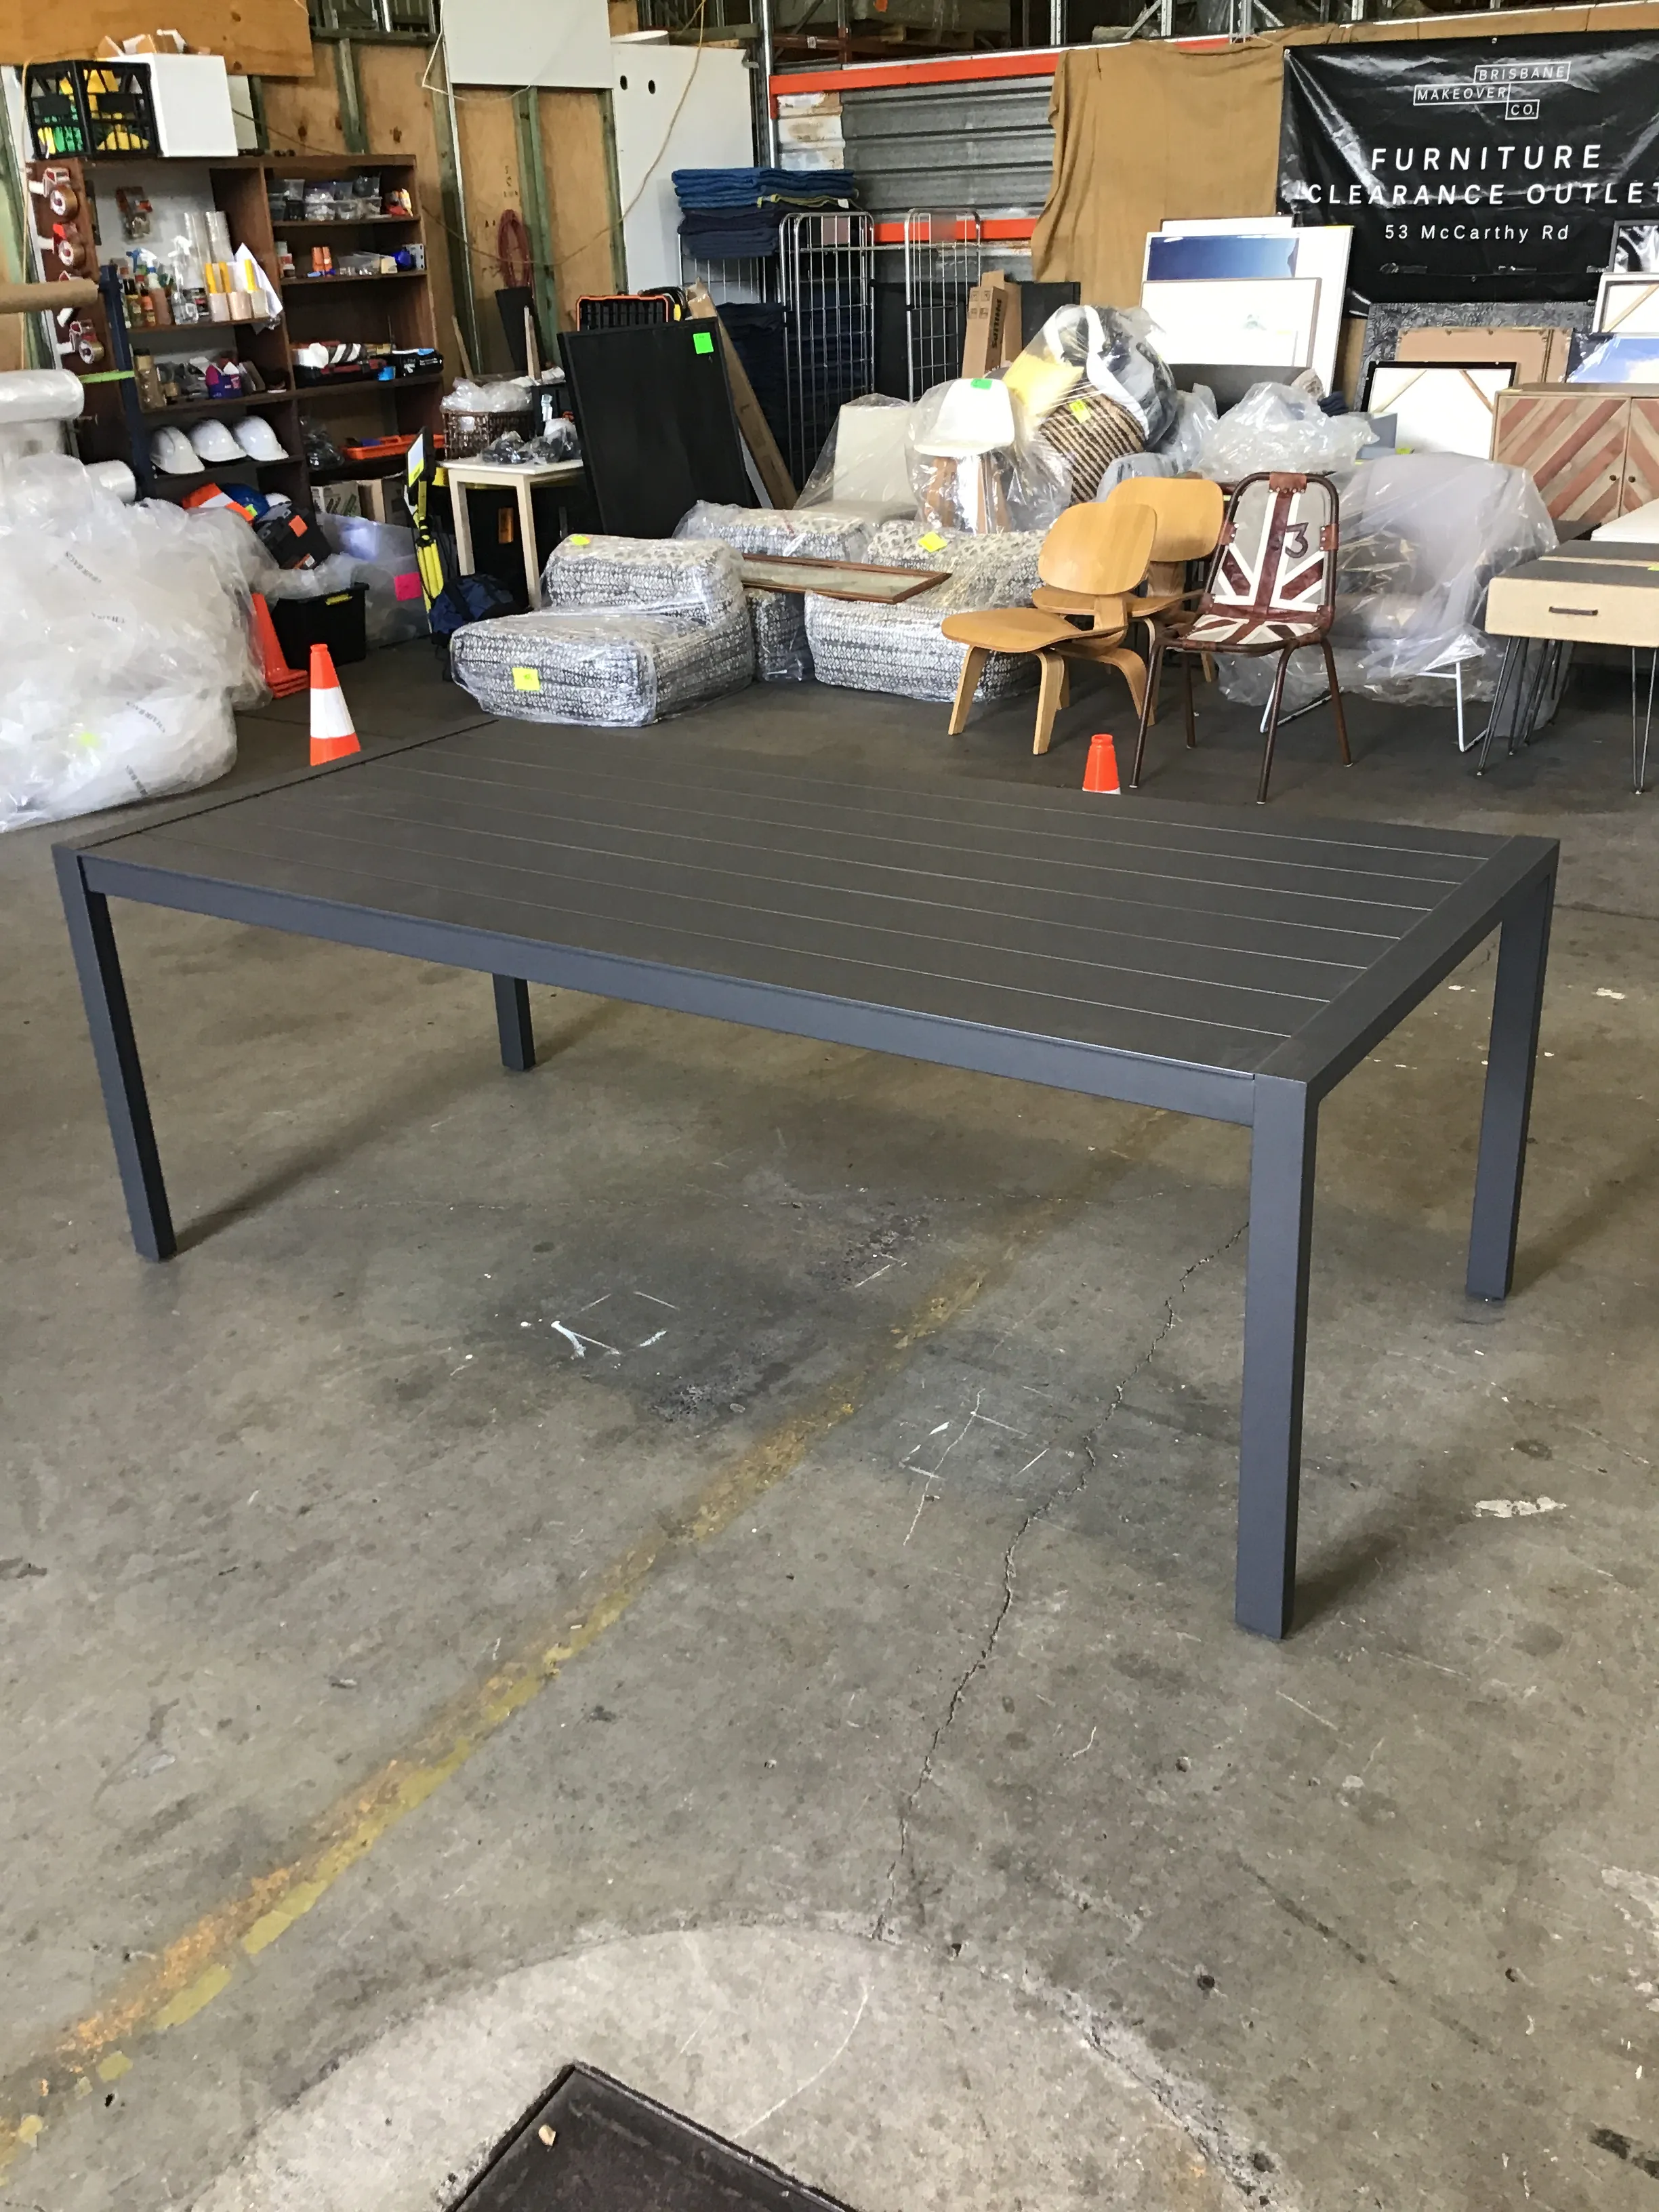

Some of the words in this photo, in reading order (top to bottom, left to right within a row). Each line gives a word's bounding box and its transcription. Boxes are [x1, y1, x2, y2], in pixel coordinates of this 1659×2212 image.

[1478, 66, 1565, 81] BRISBANE
[1417, 86, 1507, 101] MAKEOVER
[1370, 144, 1601, 171] FURNITURE
[1308, 183, 1504, 205] CLEARANCE
[1385, 224, 1408, 239] 53
[1420, 224, 1529, 243] McCarthy
[1542, 224, 1570, 240] Rd
[1285, 522, 1309, 558] 3
